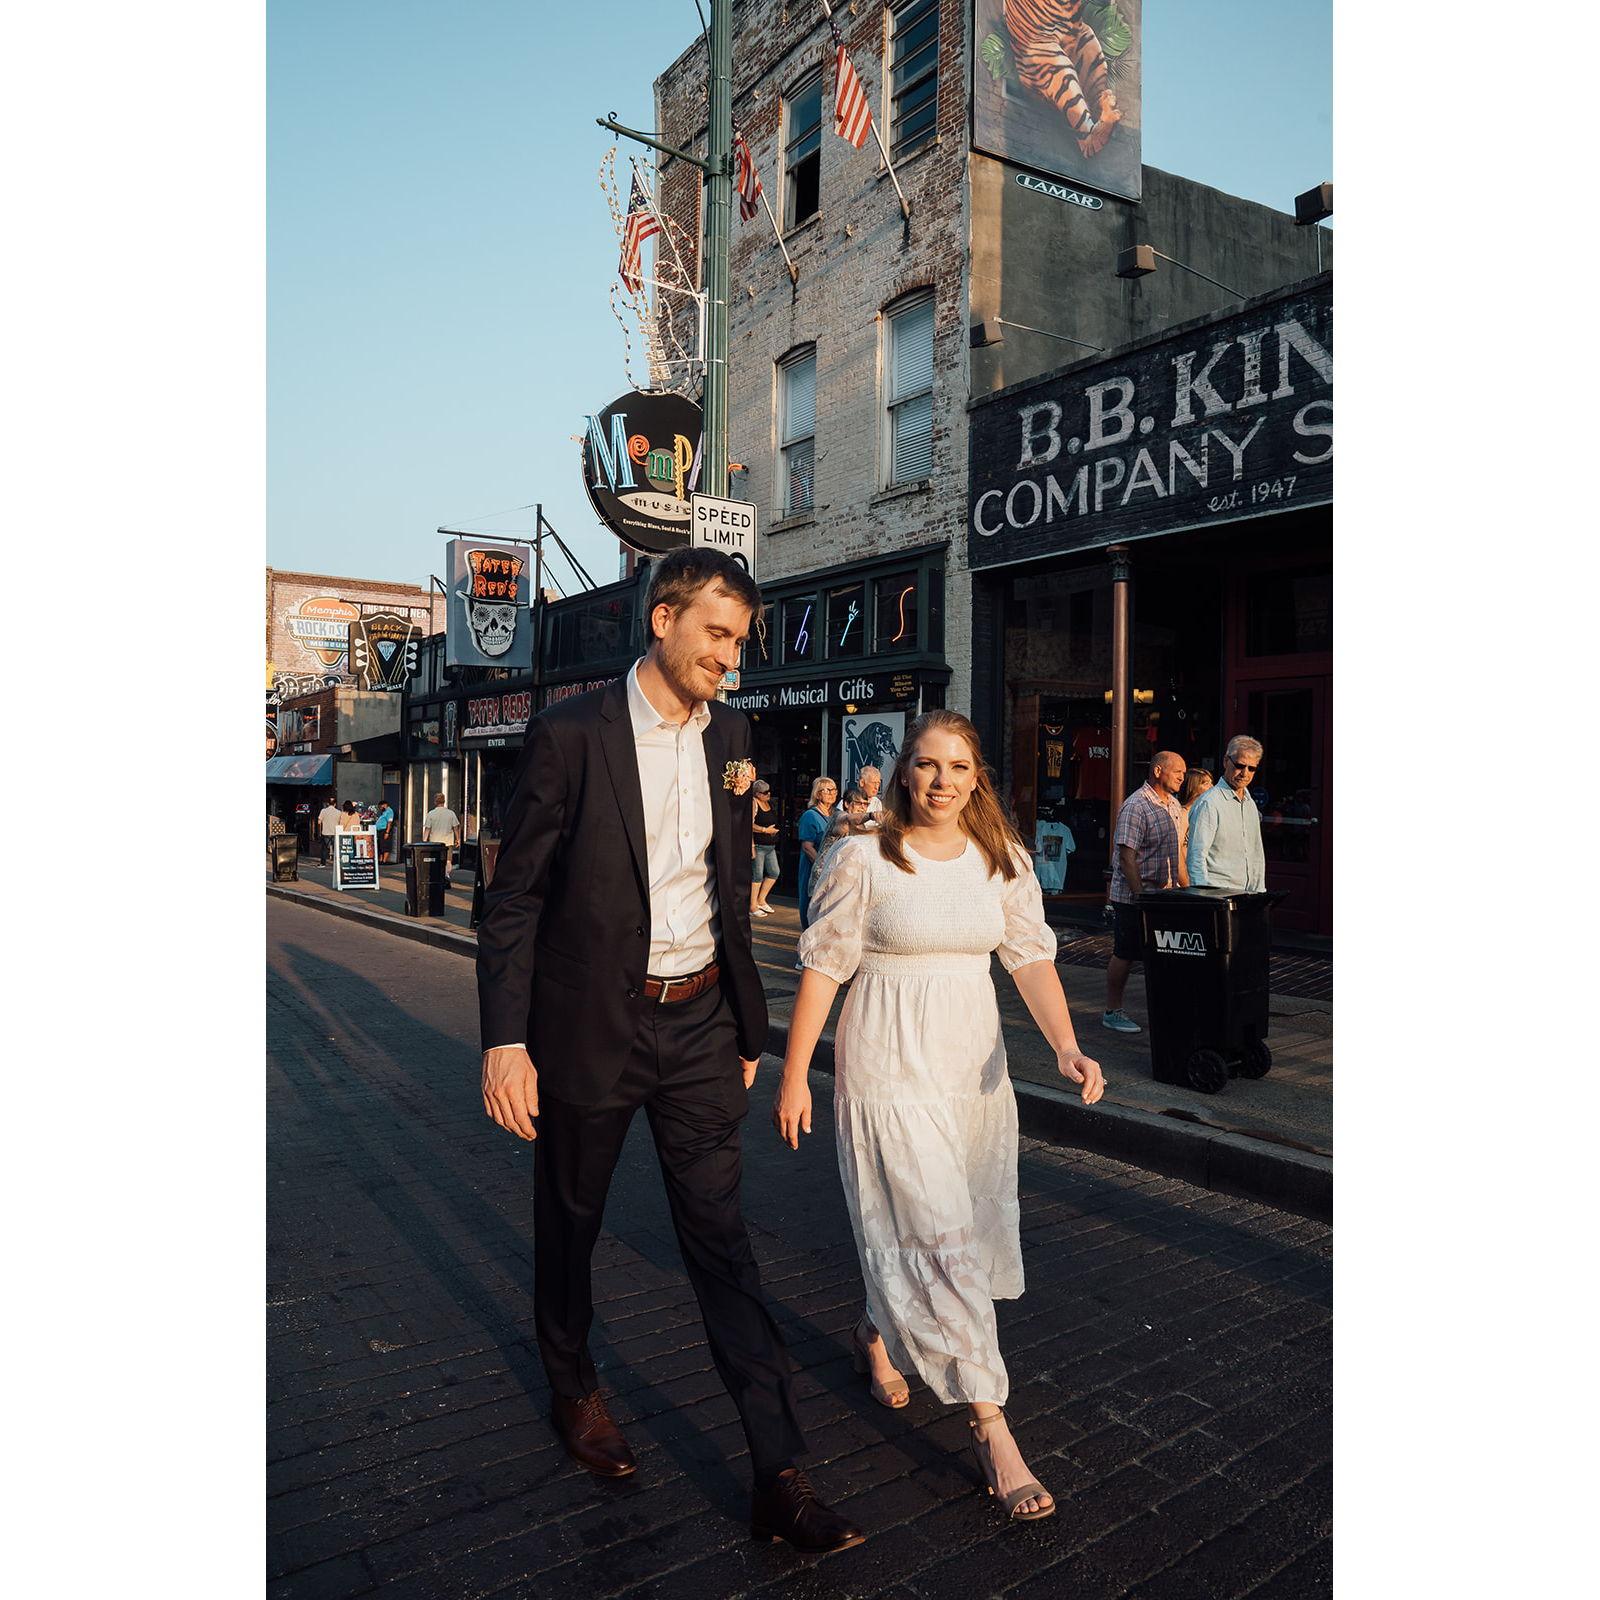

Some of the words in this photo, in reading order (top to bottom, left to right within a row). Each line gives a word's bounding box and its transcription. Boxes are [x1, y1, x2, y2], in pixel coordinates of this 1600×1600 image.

[1023, 177, 1094, 207] LAMAR
[1017, 376, 1155, 470] B.B.
[1170, 318, 1333, 427] KIN
[973, 417, 1266, 536] COMPANY
[1292, 399, 1333, 464] S
[1207, 490, 1243, 512] est.
[1251, 475, 1297, 504] 1947
[697, 506, 751, 528] SPEED
[703, 527, 745, 547] LIMIT
[306, 605, 354, 618] Memphis
[296, 621, 326, 636] ROCK
[371, 623, 403, 631] BLACK
[310, 640, 348, 649] MUSEUM
[728, 689, 769, 709] uvenirs
[779, 682, 829, 706] Musical
[839, 677, 874, 702] Gifts
[468, 697, 500, 725] TATER
[487, 738, 506, 747] ENTER
[1154, 930, 1207, 951] WM
